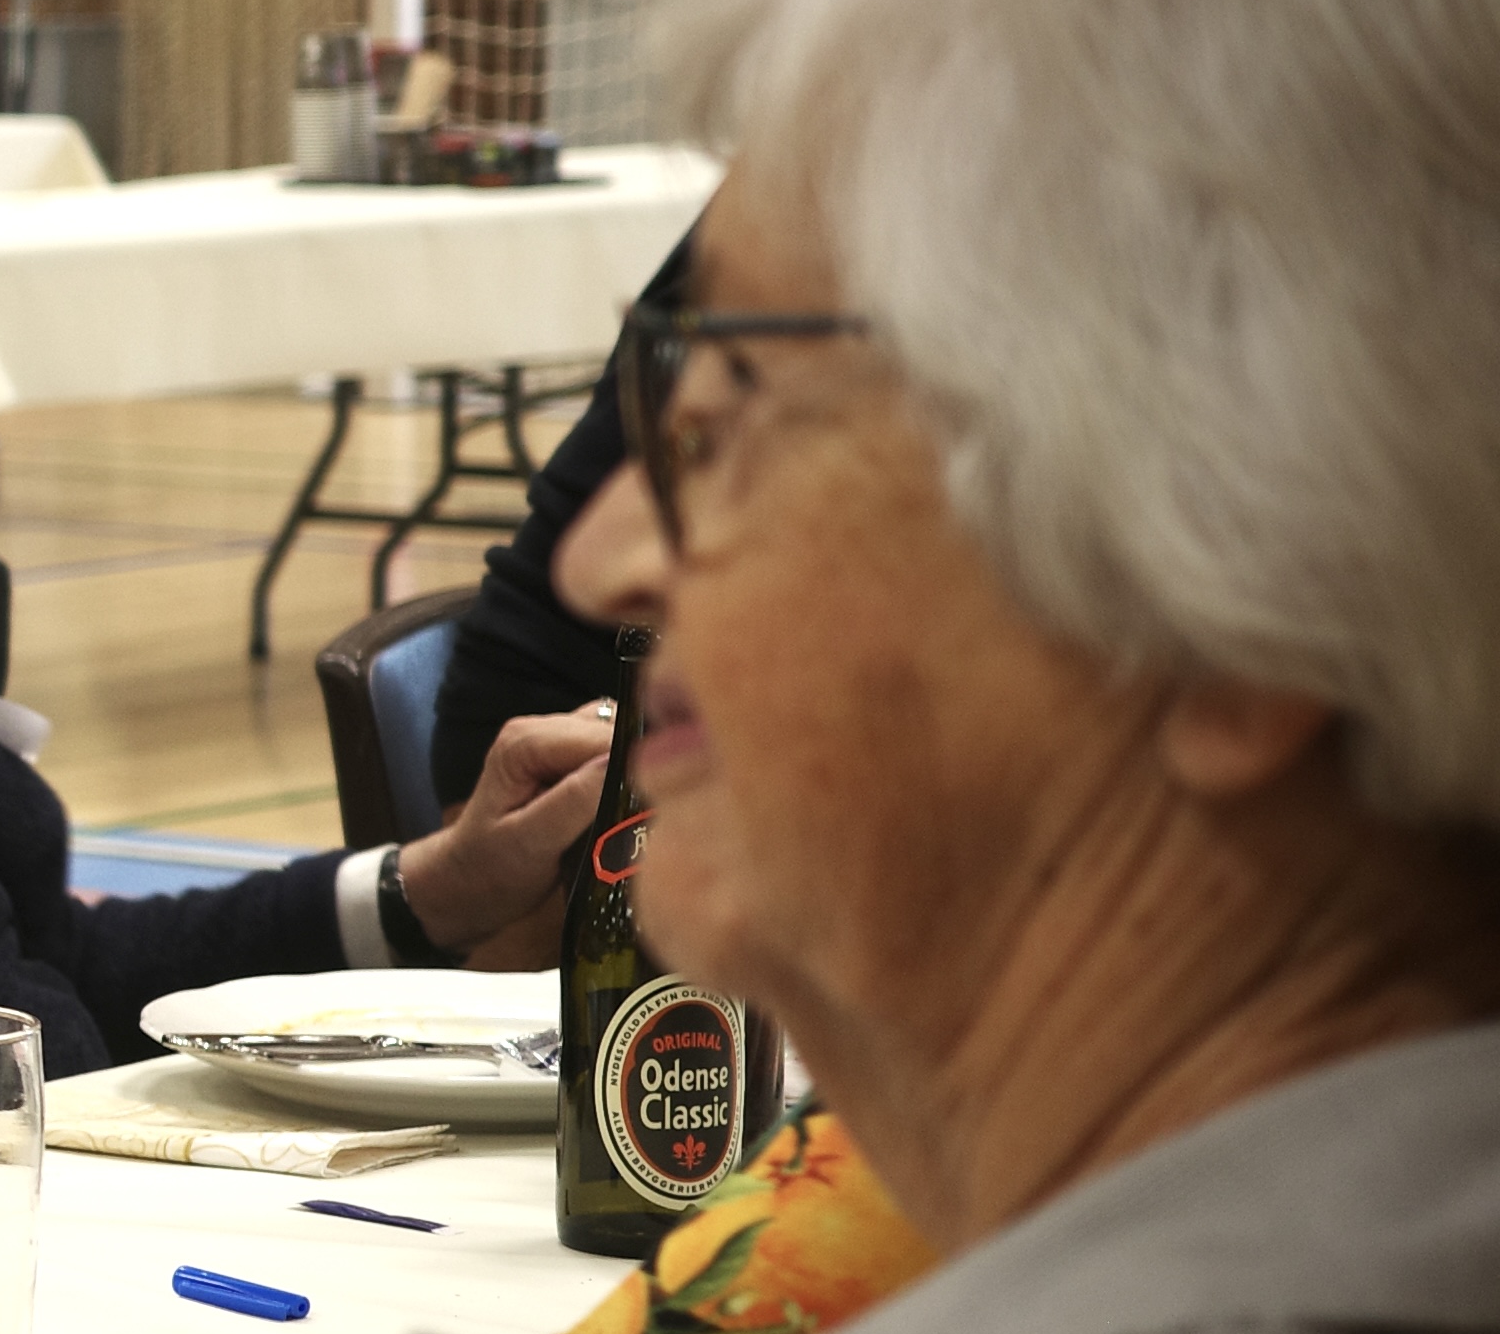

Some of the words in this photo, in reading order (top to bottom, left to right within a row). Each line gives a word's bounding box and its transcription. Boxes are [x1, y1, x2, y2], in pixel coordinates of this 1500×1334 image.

[621, 1017, 641, 1048] KOLD
[639, 1004, 654, 1020] PÅ
[655, 991, 678, 1009] FYN
[681, 989, 698, 999] OG
[652, 1032, 722, 1053] ORIGINAL
[640, 1057, 728, 1092] Odense
[640, 1092, 728, 1130] Classic
[612, 1111, 634, 1157] ALBANI
[631, 1153, 721, 1195] BRYGGERIERNE
